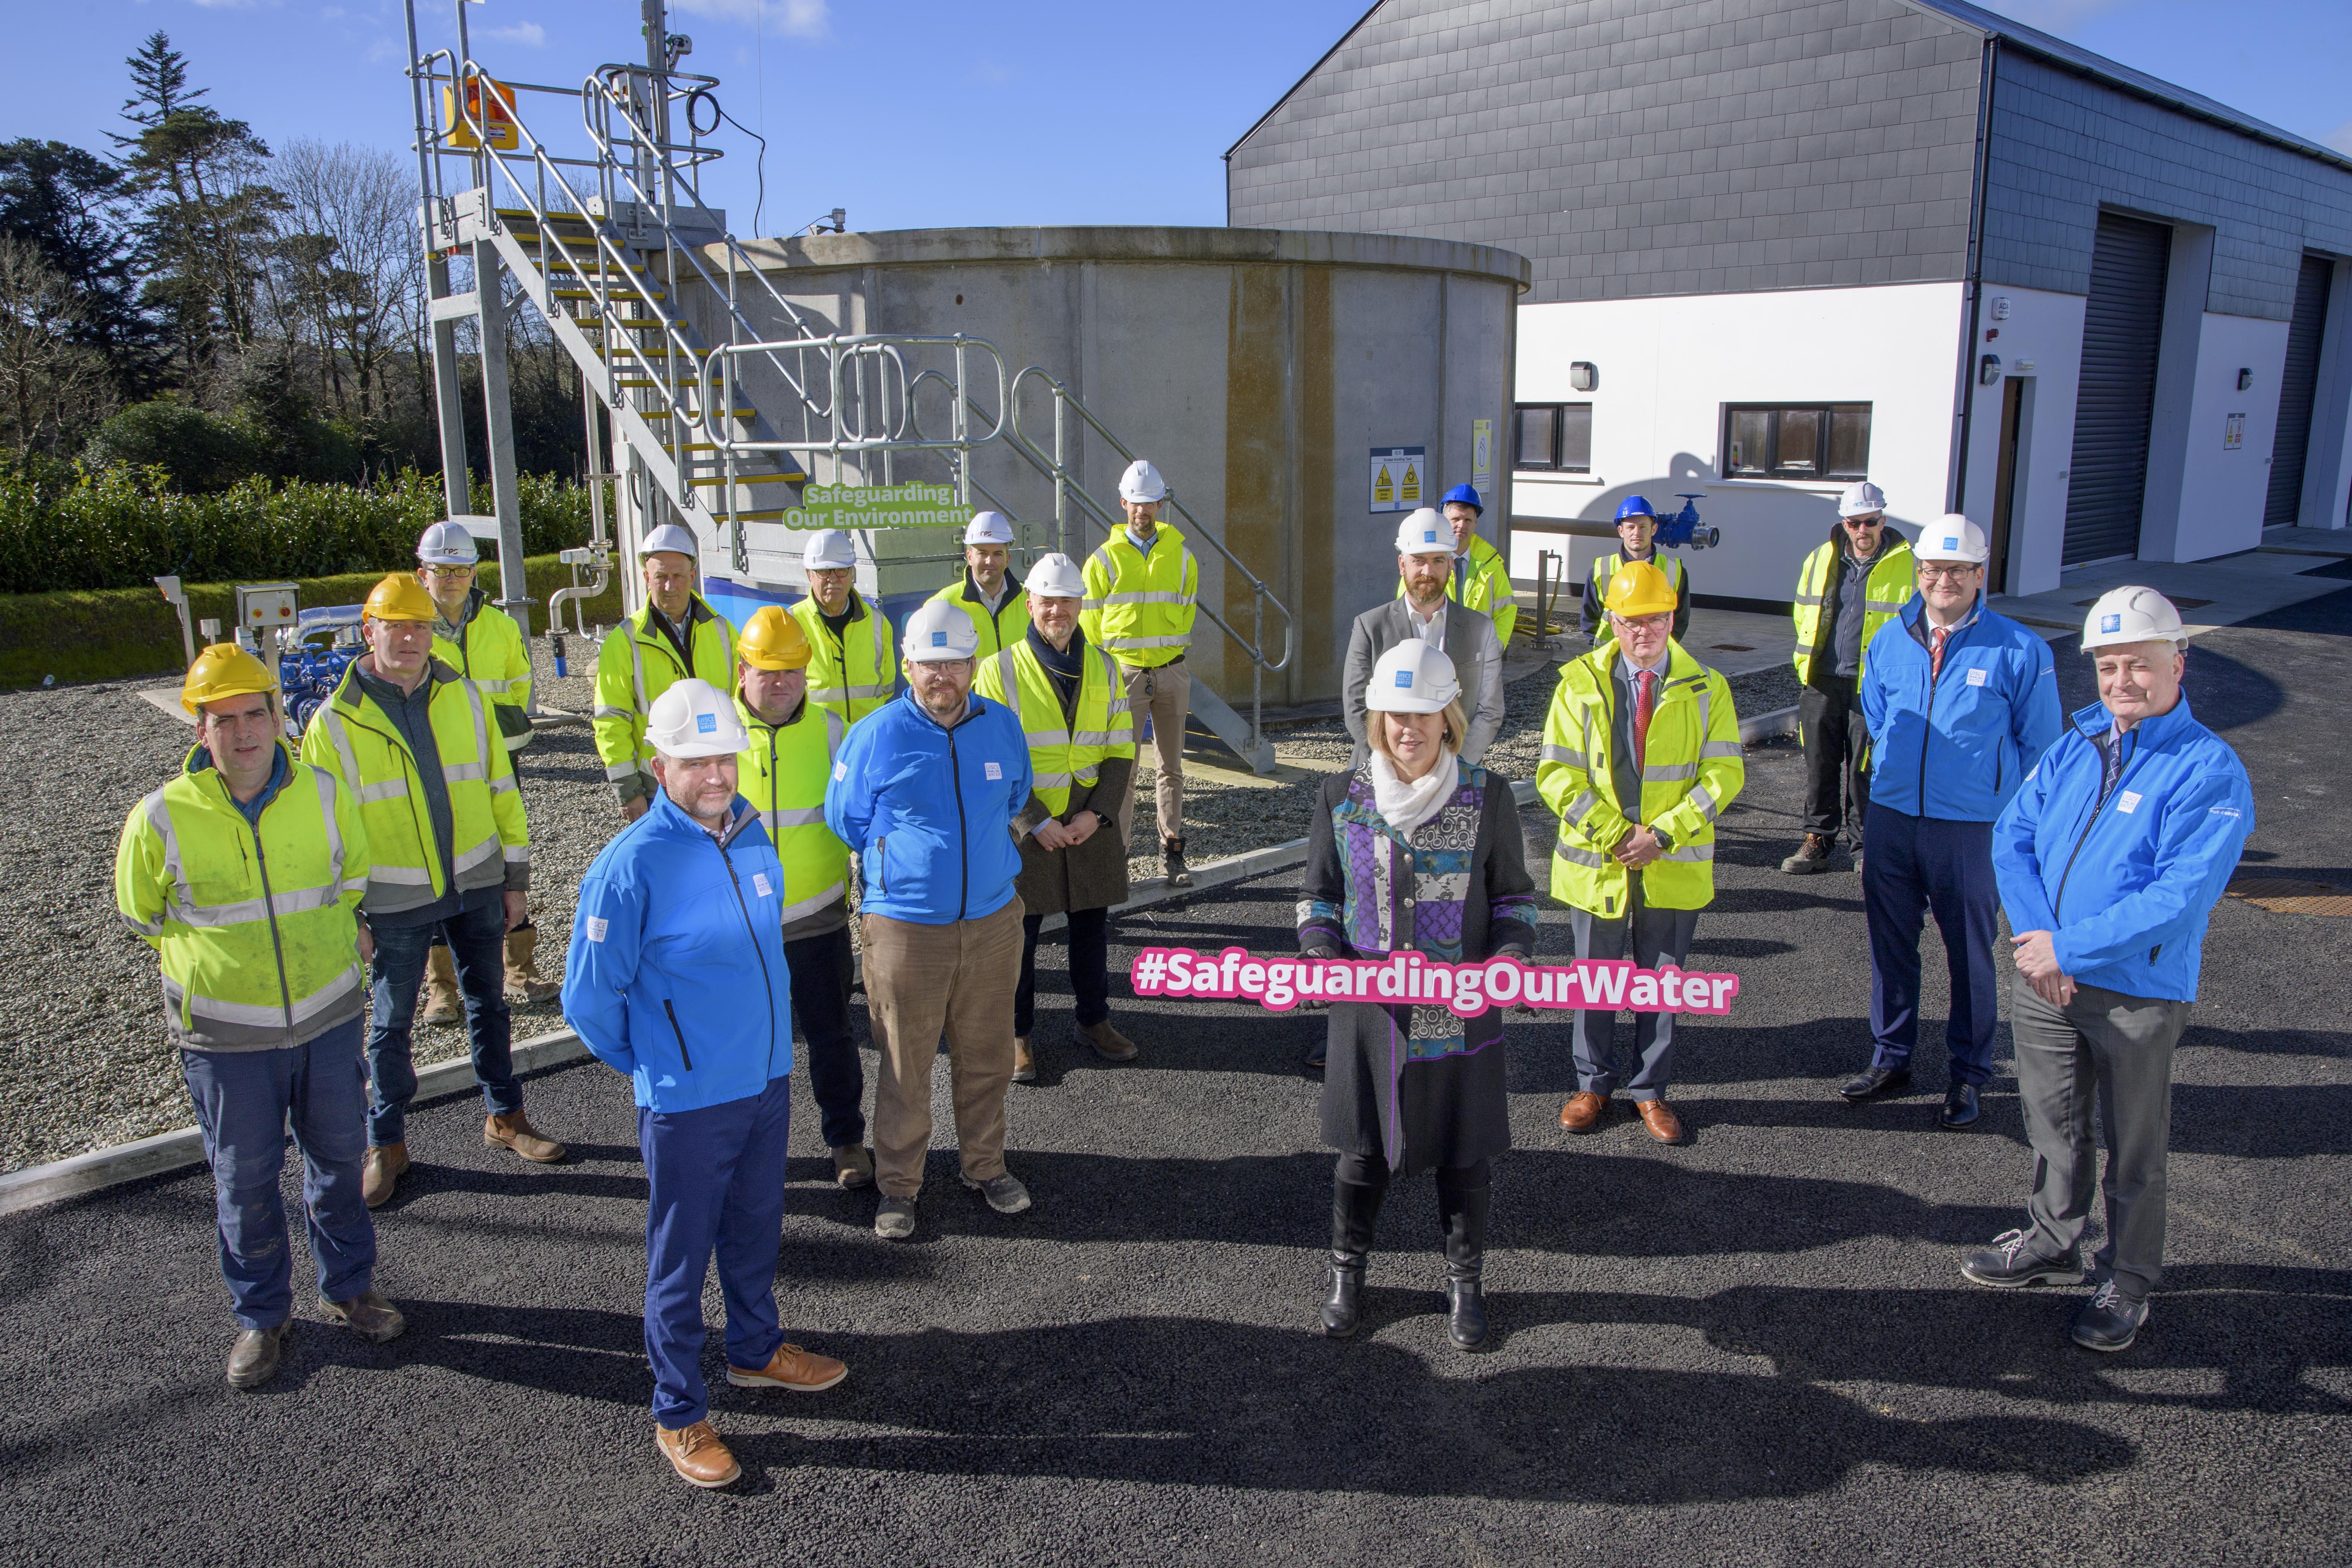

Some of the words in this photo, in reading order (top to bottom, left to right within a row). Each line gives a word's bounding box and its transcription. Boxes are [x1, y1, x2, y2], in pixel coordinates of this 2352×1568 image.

[807, 484, 950, 507] Safeguarding
[787, 510, 828, 527] Our
[833, 507, 973, 526] Environment
[2123, 794, 2140, 802] UISCE
[1137, 953, 1733, 1011] #SafeguardingOurWater
